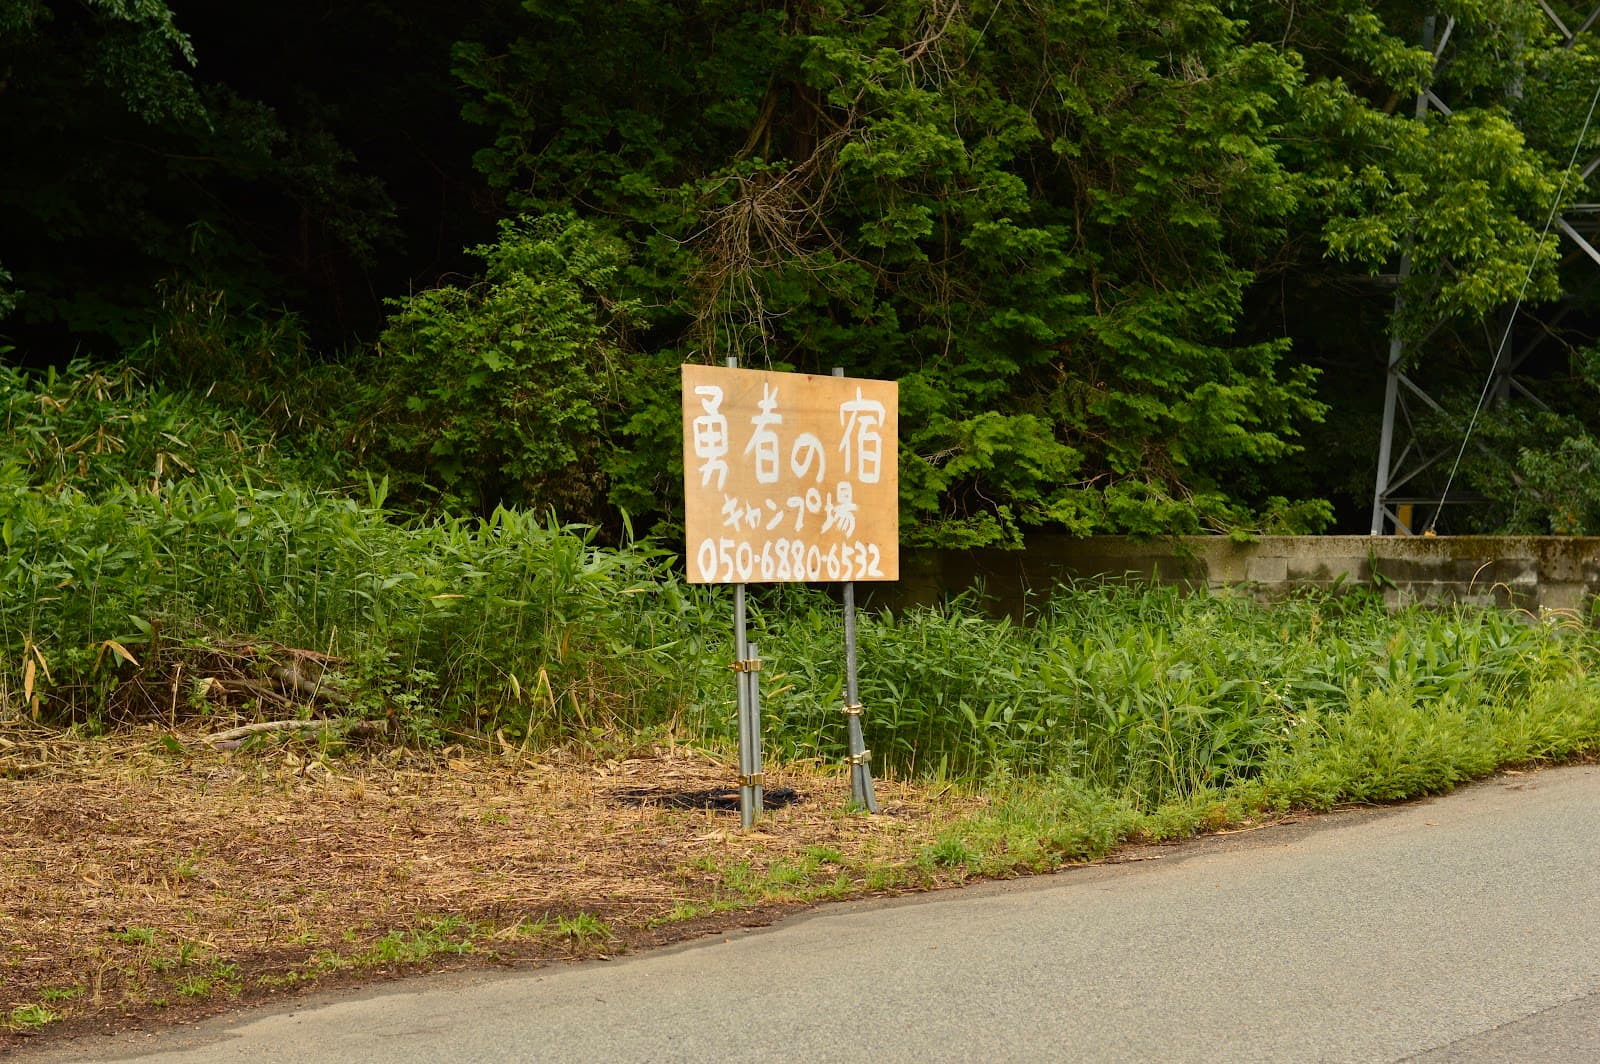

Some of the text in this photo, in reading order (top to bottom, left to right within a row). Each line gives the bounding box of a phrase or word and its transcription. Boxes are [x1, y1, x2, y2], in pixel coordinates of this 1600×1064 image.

[694, 382, 886, 491] 勇者の宿
[722, 481, 858, 538] キャンプ場
[697, 537, 884, 582] 050-6880-6532
